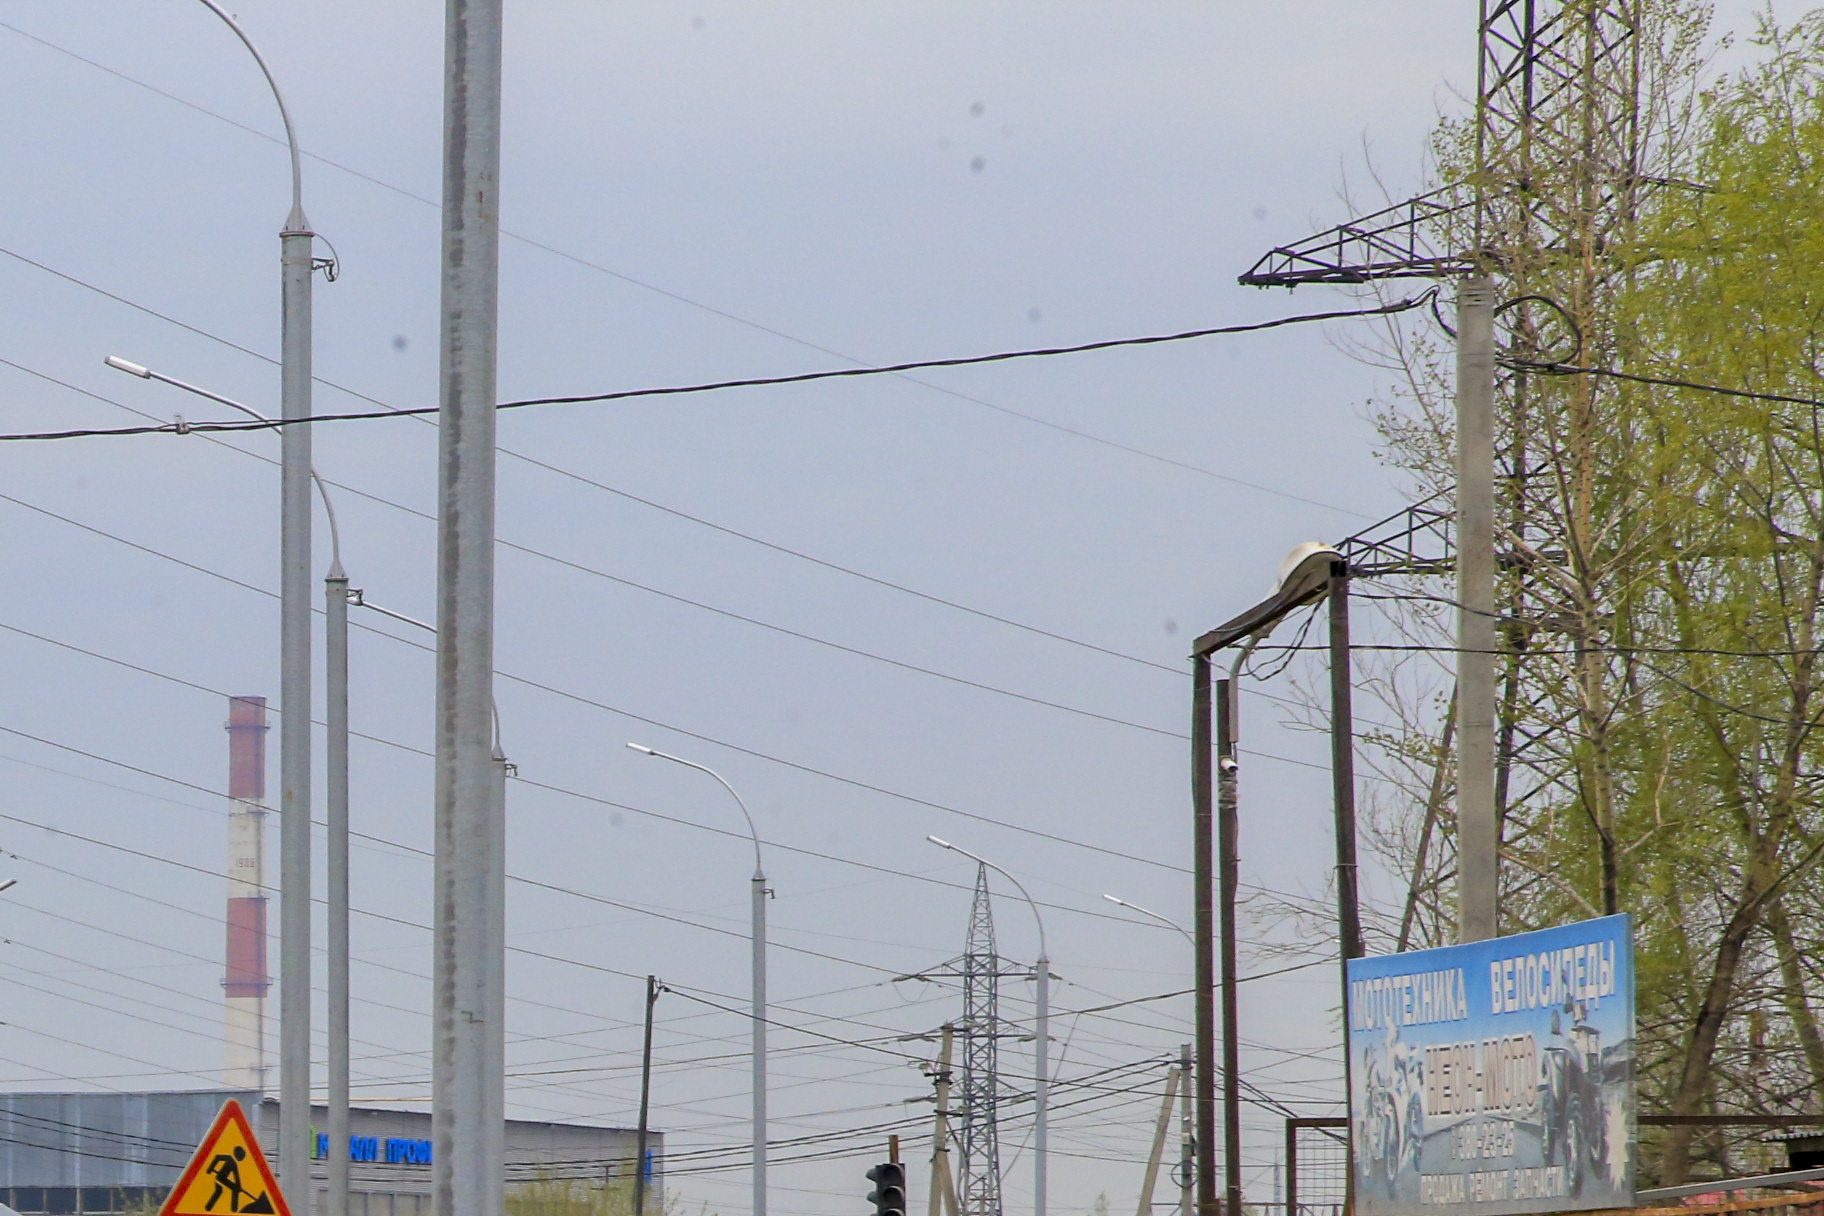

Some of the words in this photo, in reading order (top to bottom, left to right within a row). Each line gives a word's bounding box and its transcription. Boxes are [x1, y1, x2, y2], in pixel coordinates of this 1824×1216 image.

[1352, 967, 1468, 1031] МОТОТЕХНИКА
[1490, 939, 1616, 1015] ВЕЛОСИПЕДЫ
[1425, 1033, 1537, 1117] НЕОН-МОТО
[1420, 1174, 1465, 1205] ПРОДАЖА
[1469, 1169, 1509, 1202] РЕМОНТ
[1512, 1165, 1565, 1200] ЗАПЧАСТИ
